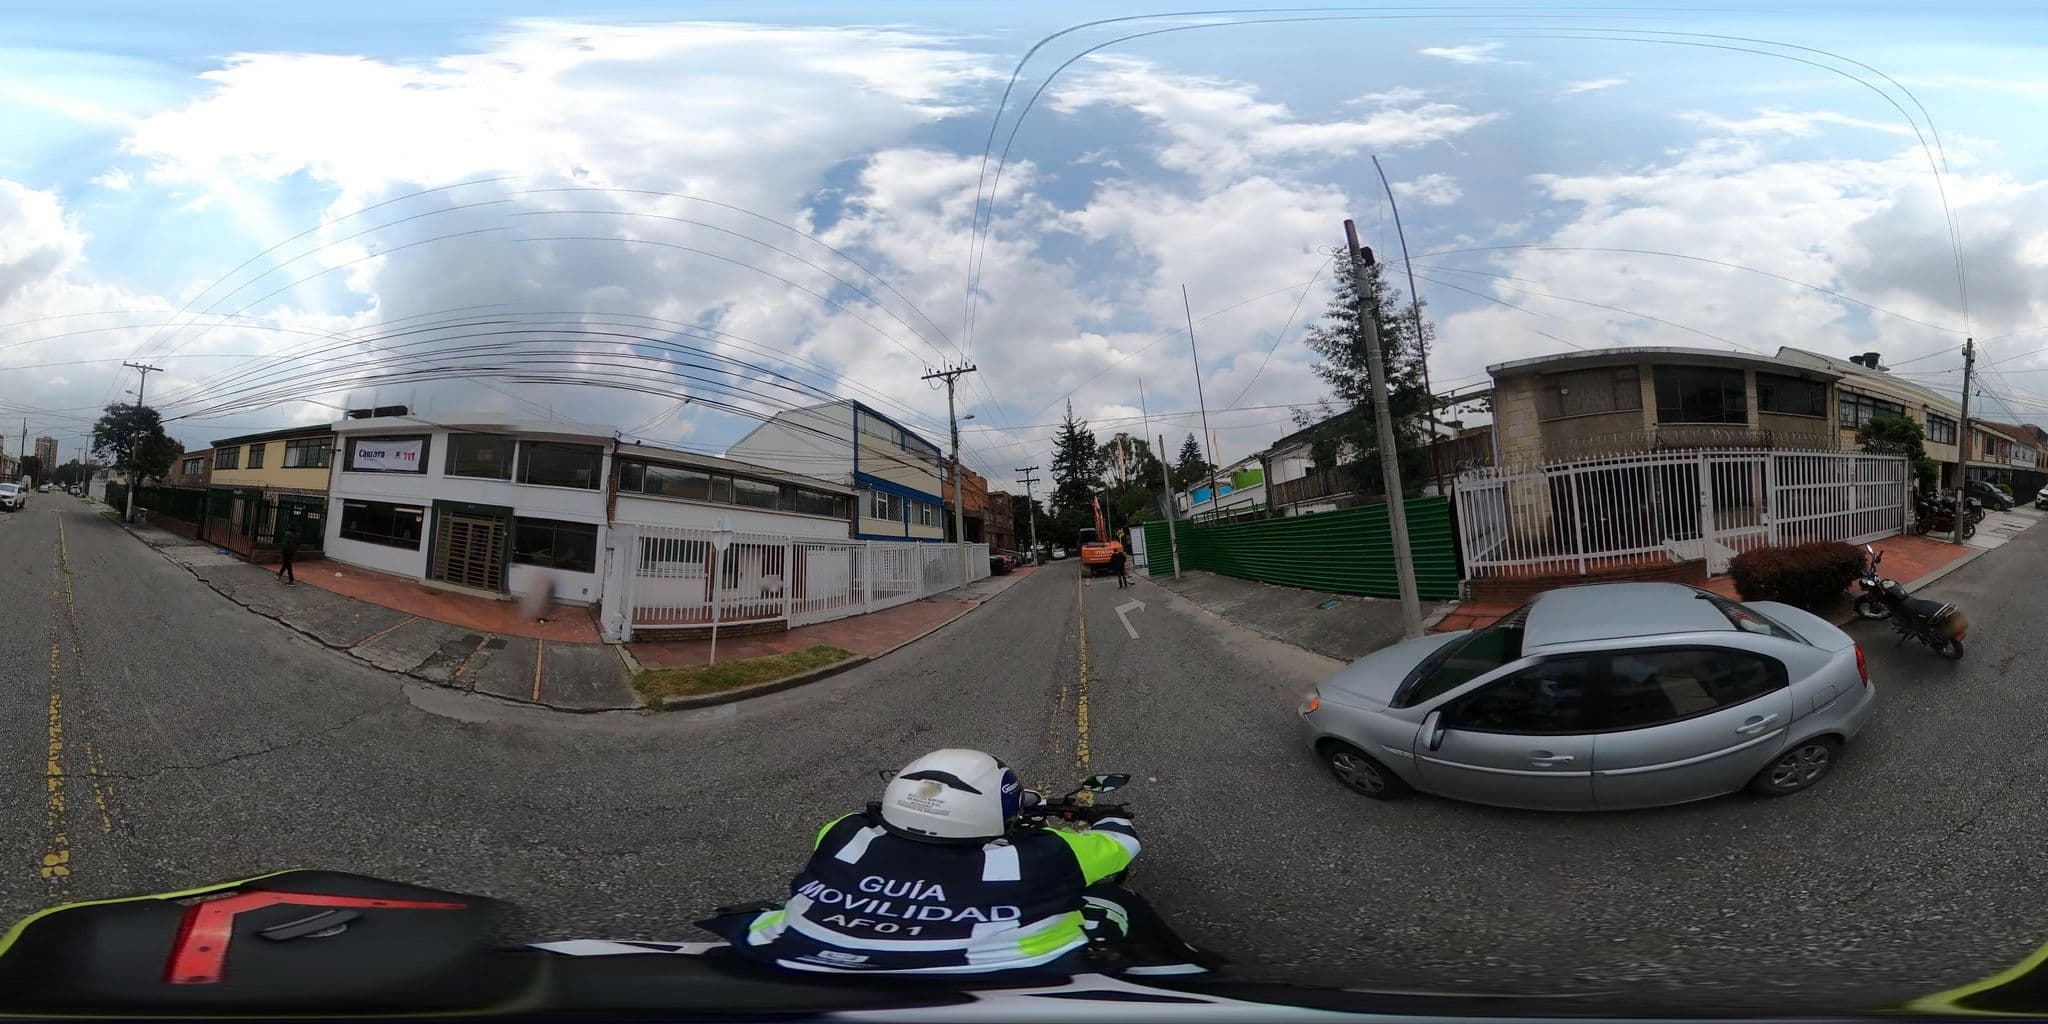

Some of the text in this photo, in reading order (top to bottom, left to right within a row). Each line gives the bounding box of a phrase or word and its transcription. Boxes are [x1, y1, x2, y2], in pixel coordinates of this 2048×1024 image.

[798, 880, 1021, 922] MOVILIDAD
[859, 875, 946, 901] GUÍA
[822, 914, 923, 936] AF01
